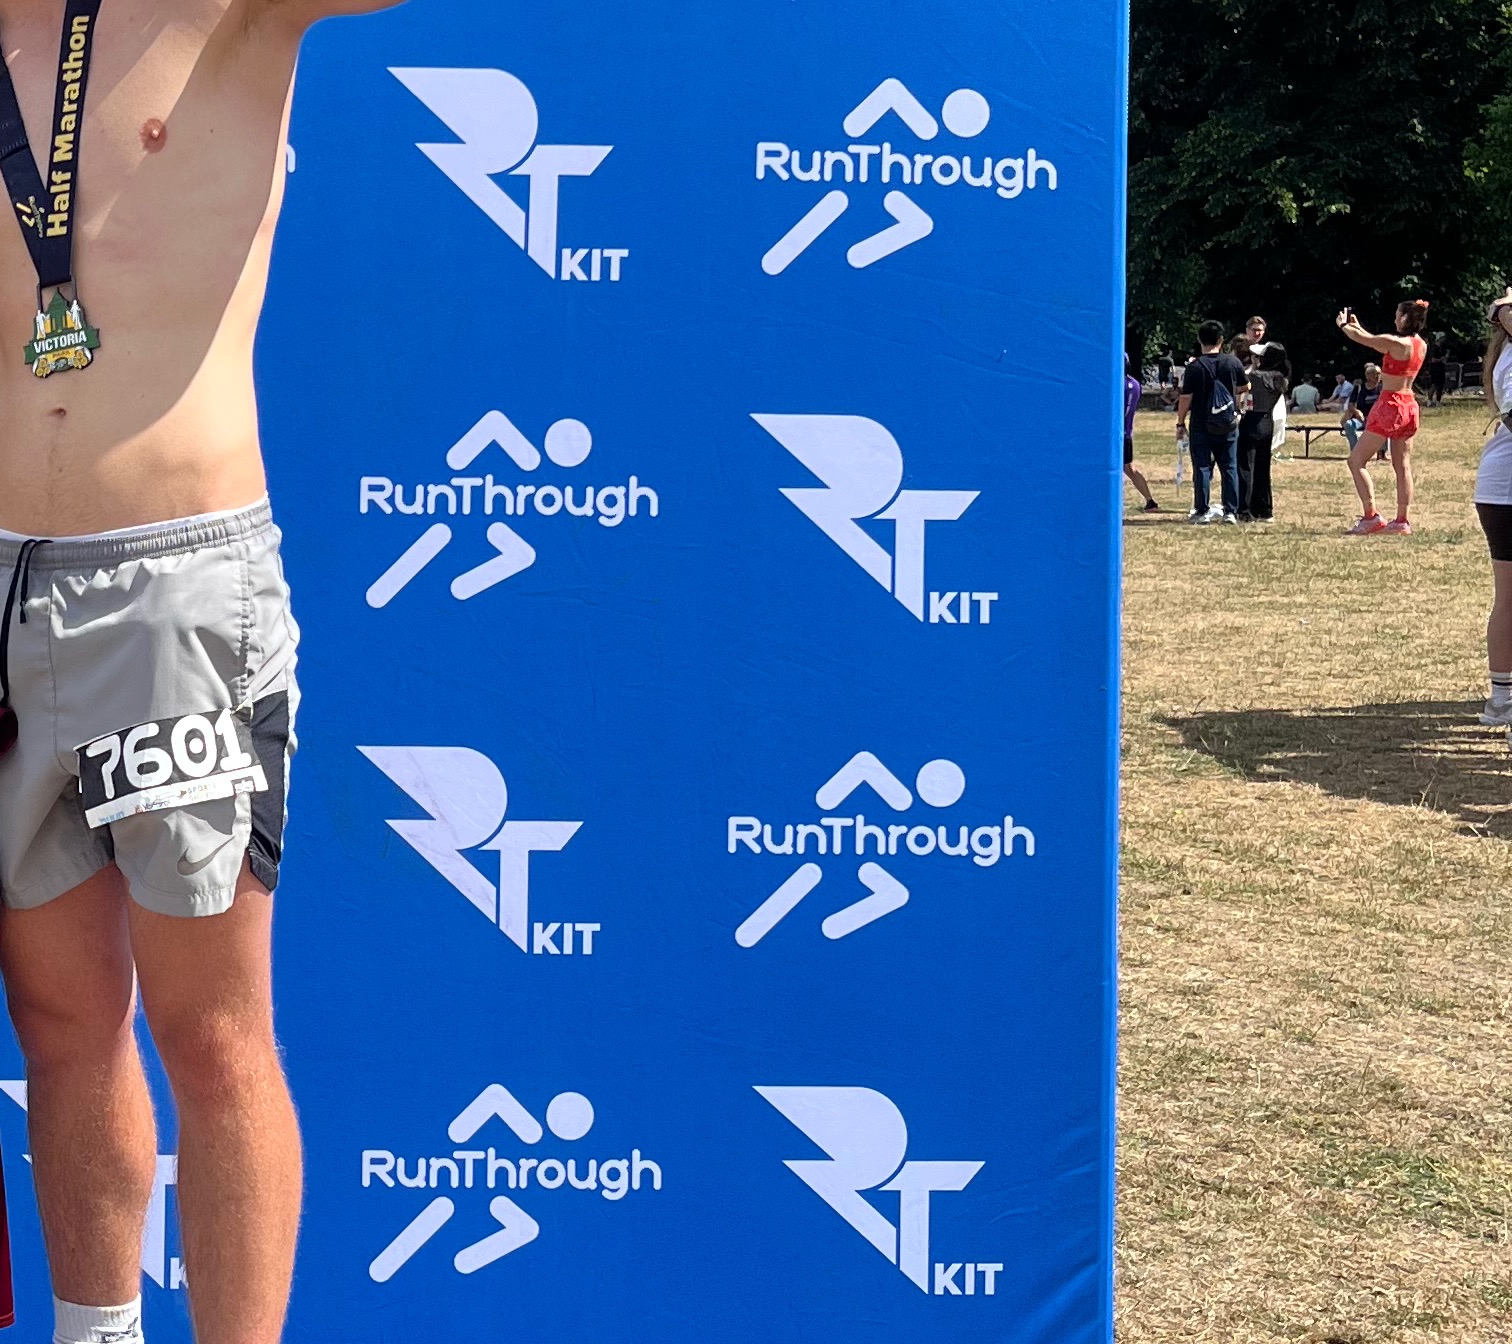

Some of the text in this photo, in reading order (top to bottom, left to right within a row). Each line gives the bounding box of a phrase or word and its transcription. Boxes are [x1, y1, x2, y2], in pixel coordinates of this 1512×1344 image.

[46, 14, 90, 239] Half Marathon
[756, 142, 1057, 198] RunThrough
[561, 248, 629, 281] KIT
[34, 330, 87, 354] VICTORIA
[360, 474, 658, 527] RunThrough
[930, 592, 998, 623] KIT
[86, 708, 252, 800] 7601
[728, 815, 1035, 866] RunThrough
[533, 923, 600, 954] KIT
[362, 1147, 661, 1200] RunThrough
[934, 1263, 1003, 1295] KIT
